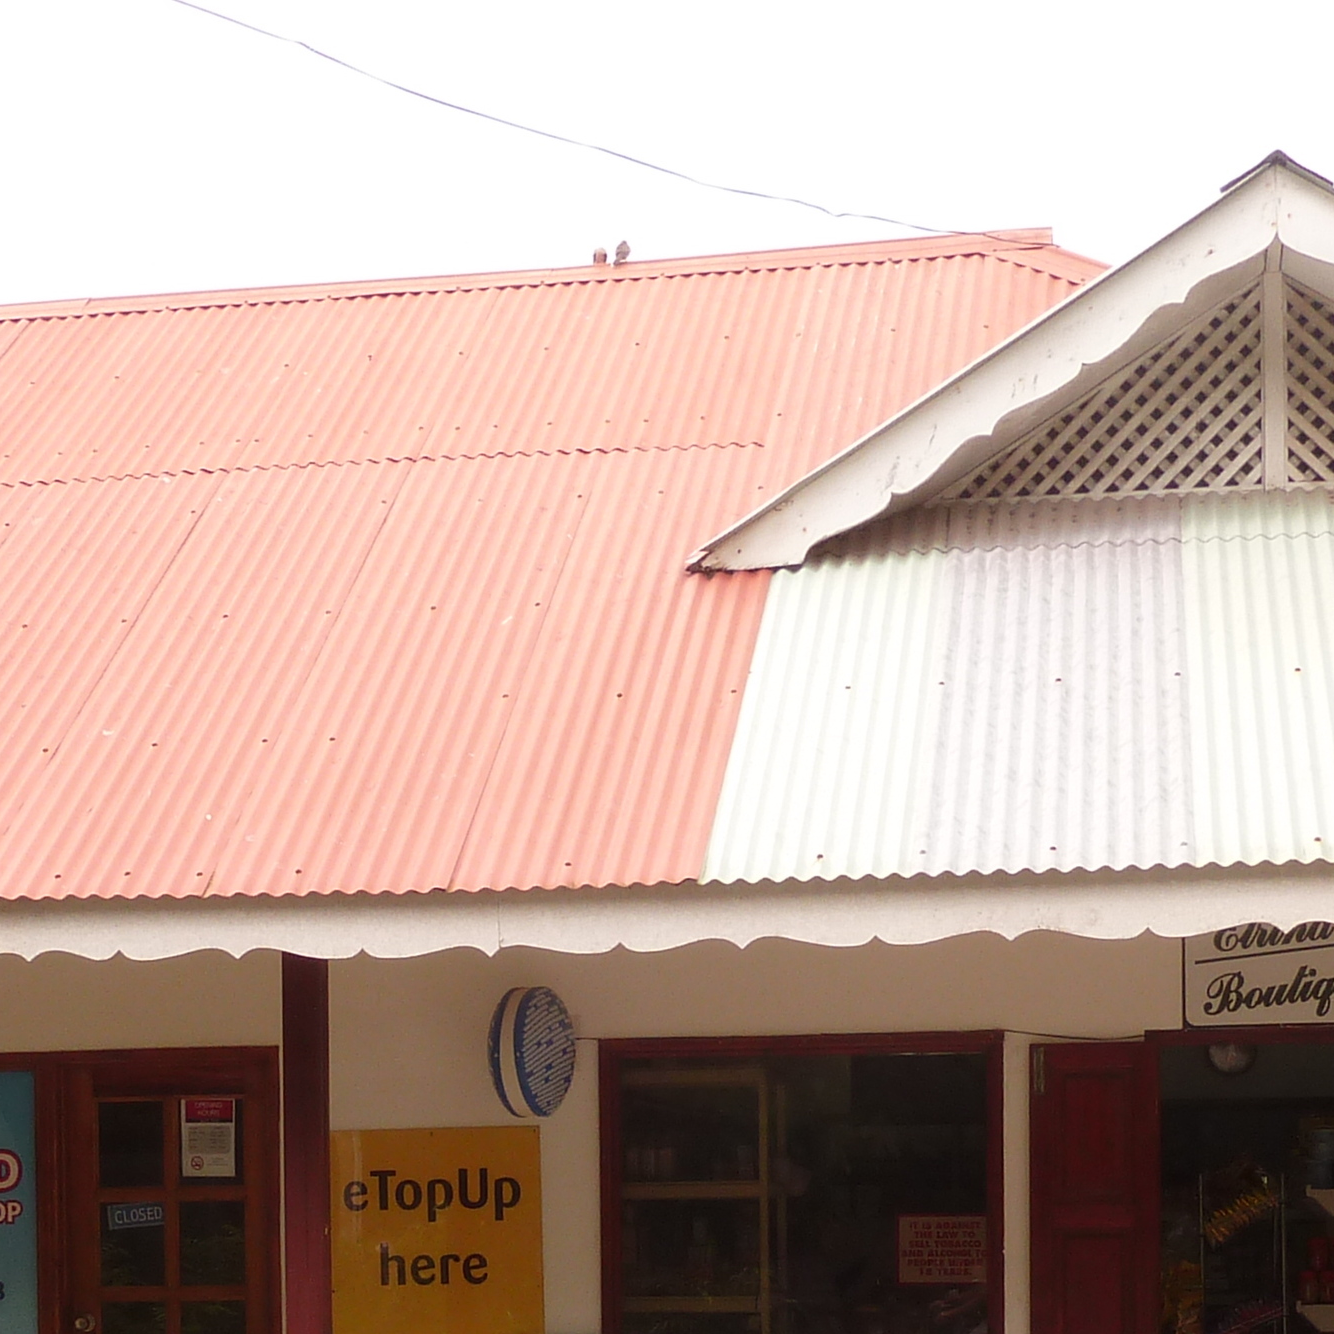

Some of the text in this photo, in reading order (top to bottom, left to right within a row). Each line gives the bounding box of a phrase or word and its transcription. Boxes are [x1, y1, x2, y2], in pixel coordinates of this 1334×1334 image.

[343, 1168, 521, 1223] eTopUp
[114, 1206, 163, 1224] CLOSED
[935, 1240, 982, 1248] TOBACCO
[936, 1231, 958, 1239] LAW
[962, 1231, 976, 1239] TO
[380, 1242, 488, 1286] here
